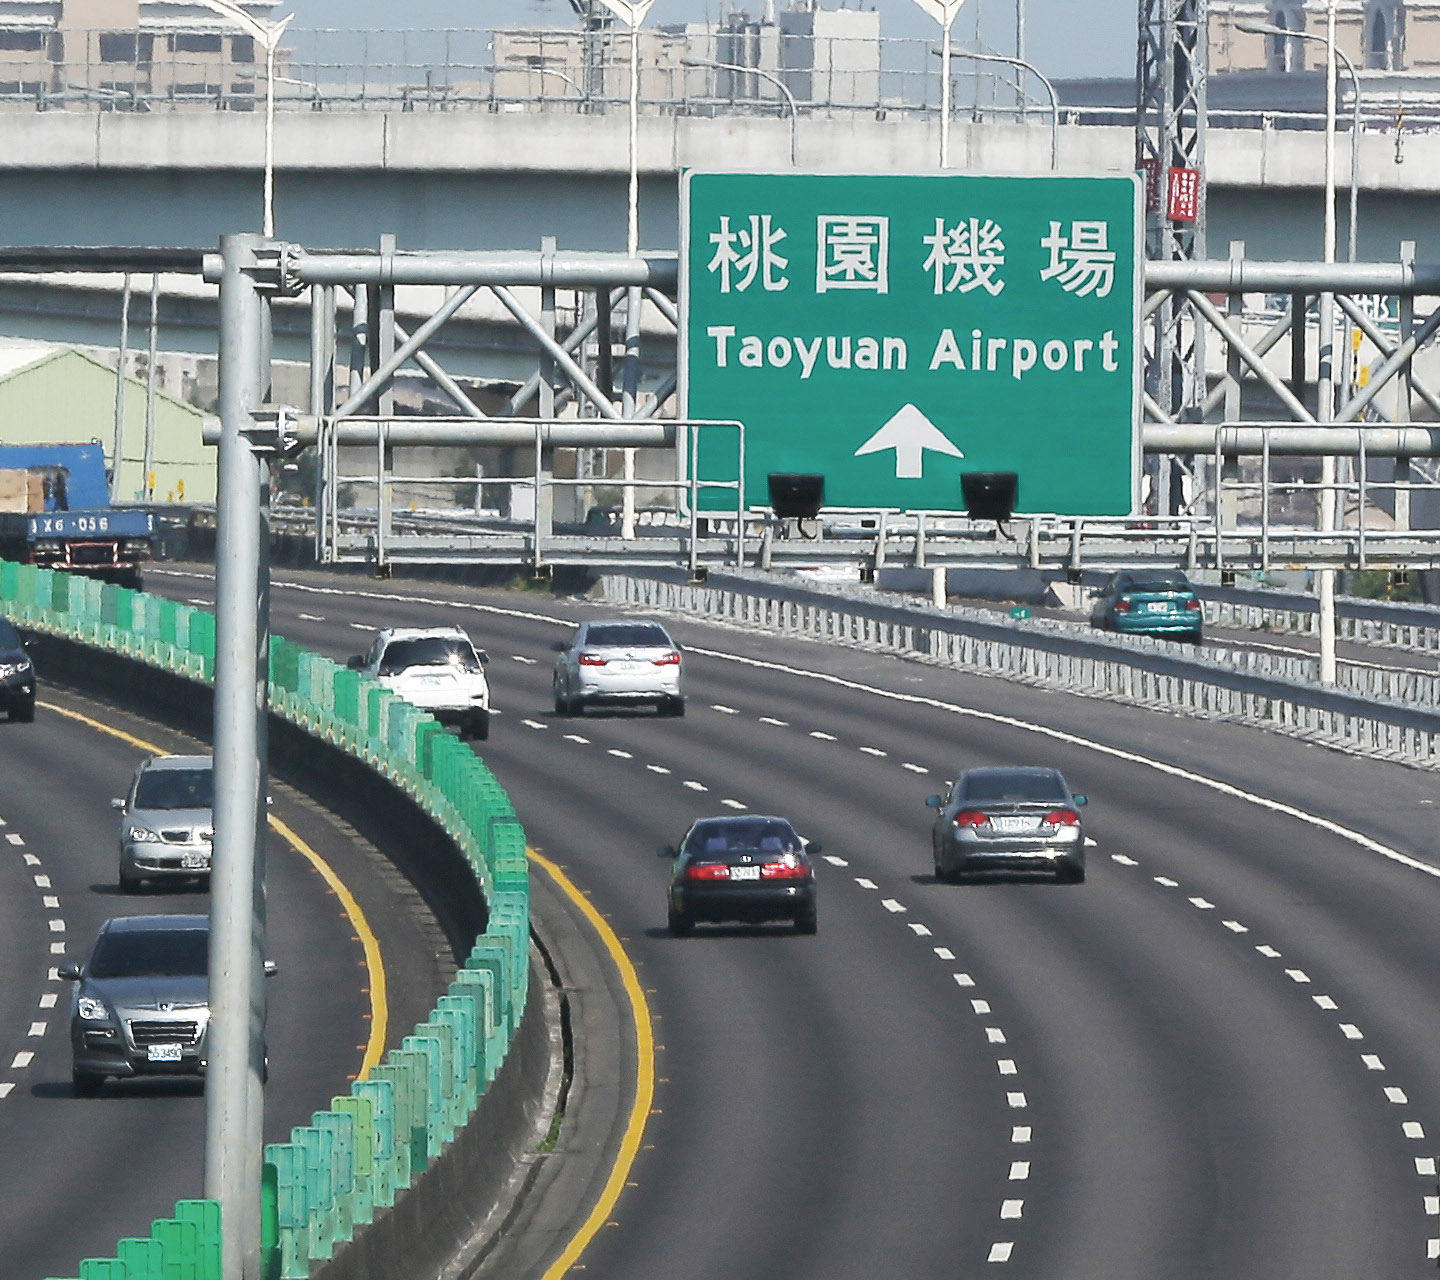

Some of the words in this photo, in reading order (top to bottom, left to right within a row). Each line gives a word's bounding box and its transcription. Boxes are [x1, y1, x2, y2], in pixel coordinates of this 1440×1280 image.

[707, 214, 1117, 298] 桃園機場
[706, 325, 908, 380] Taoyuan
[928, 328, 1119, 381] Airport
